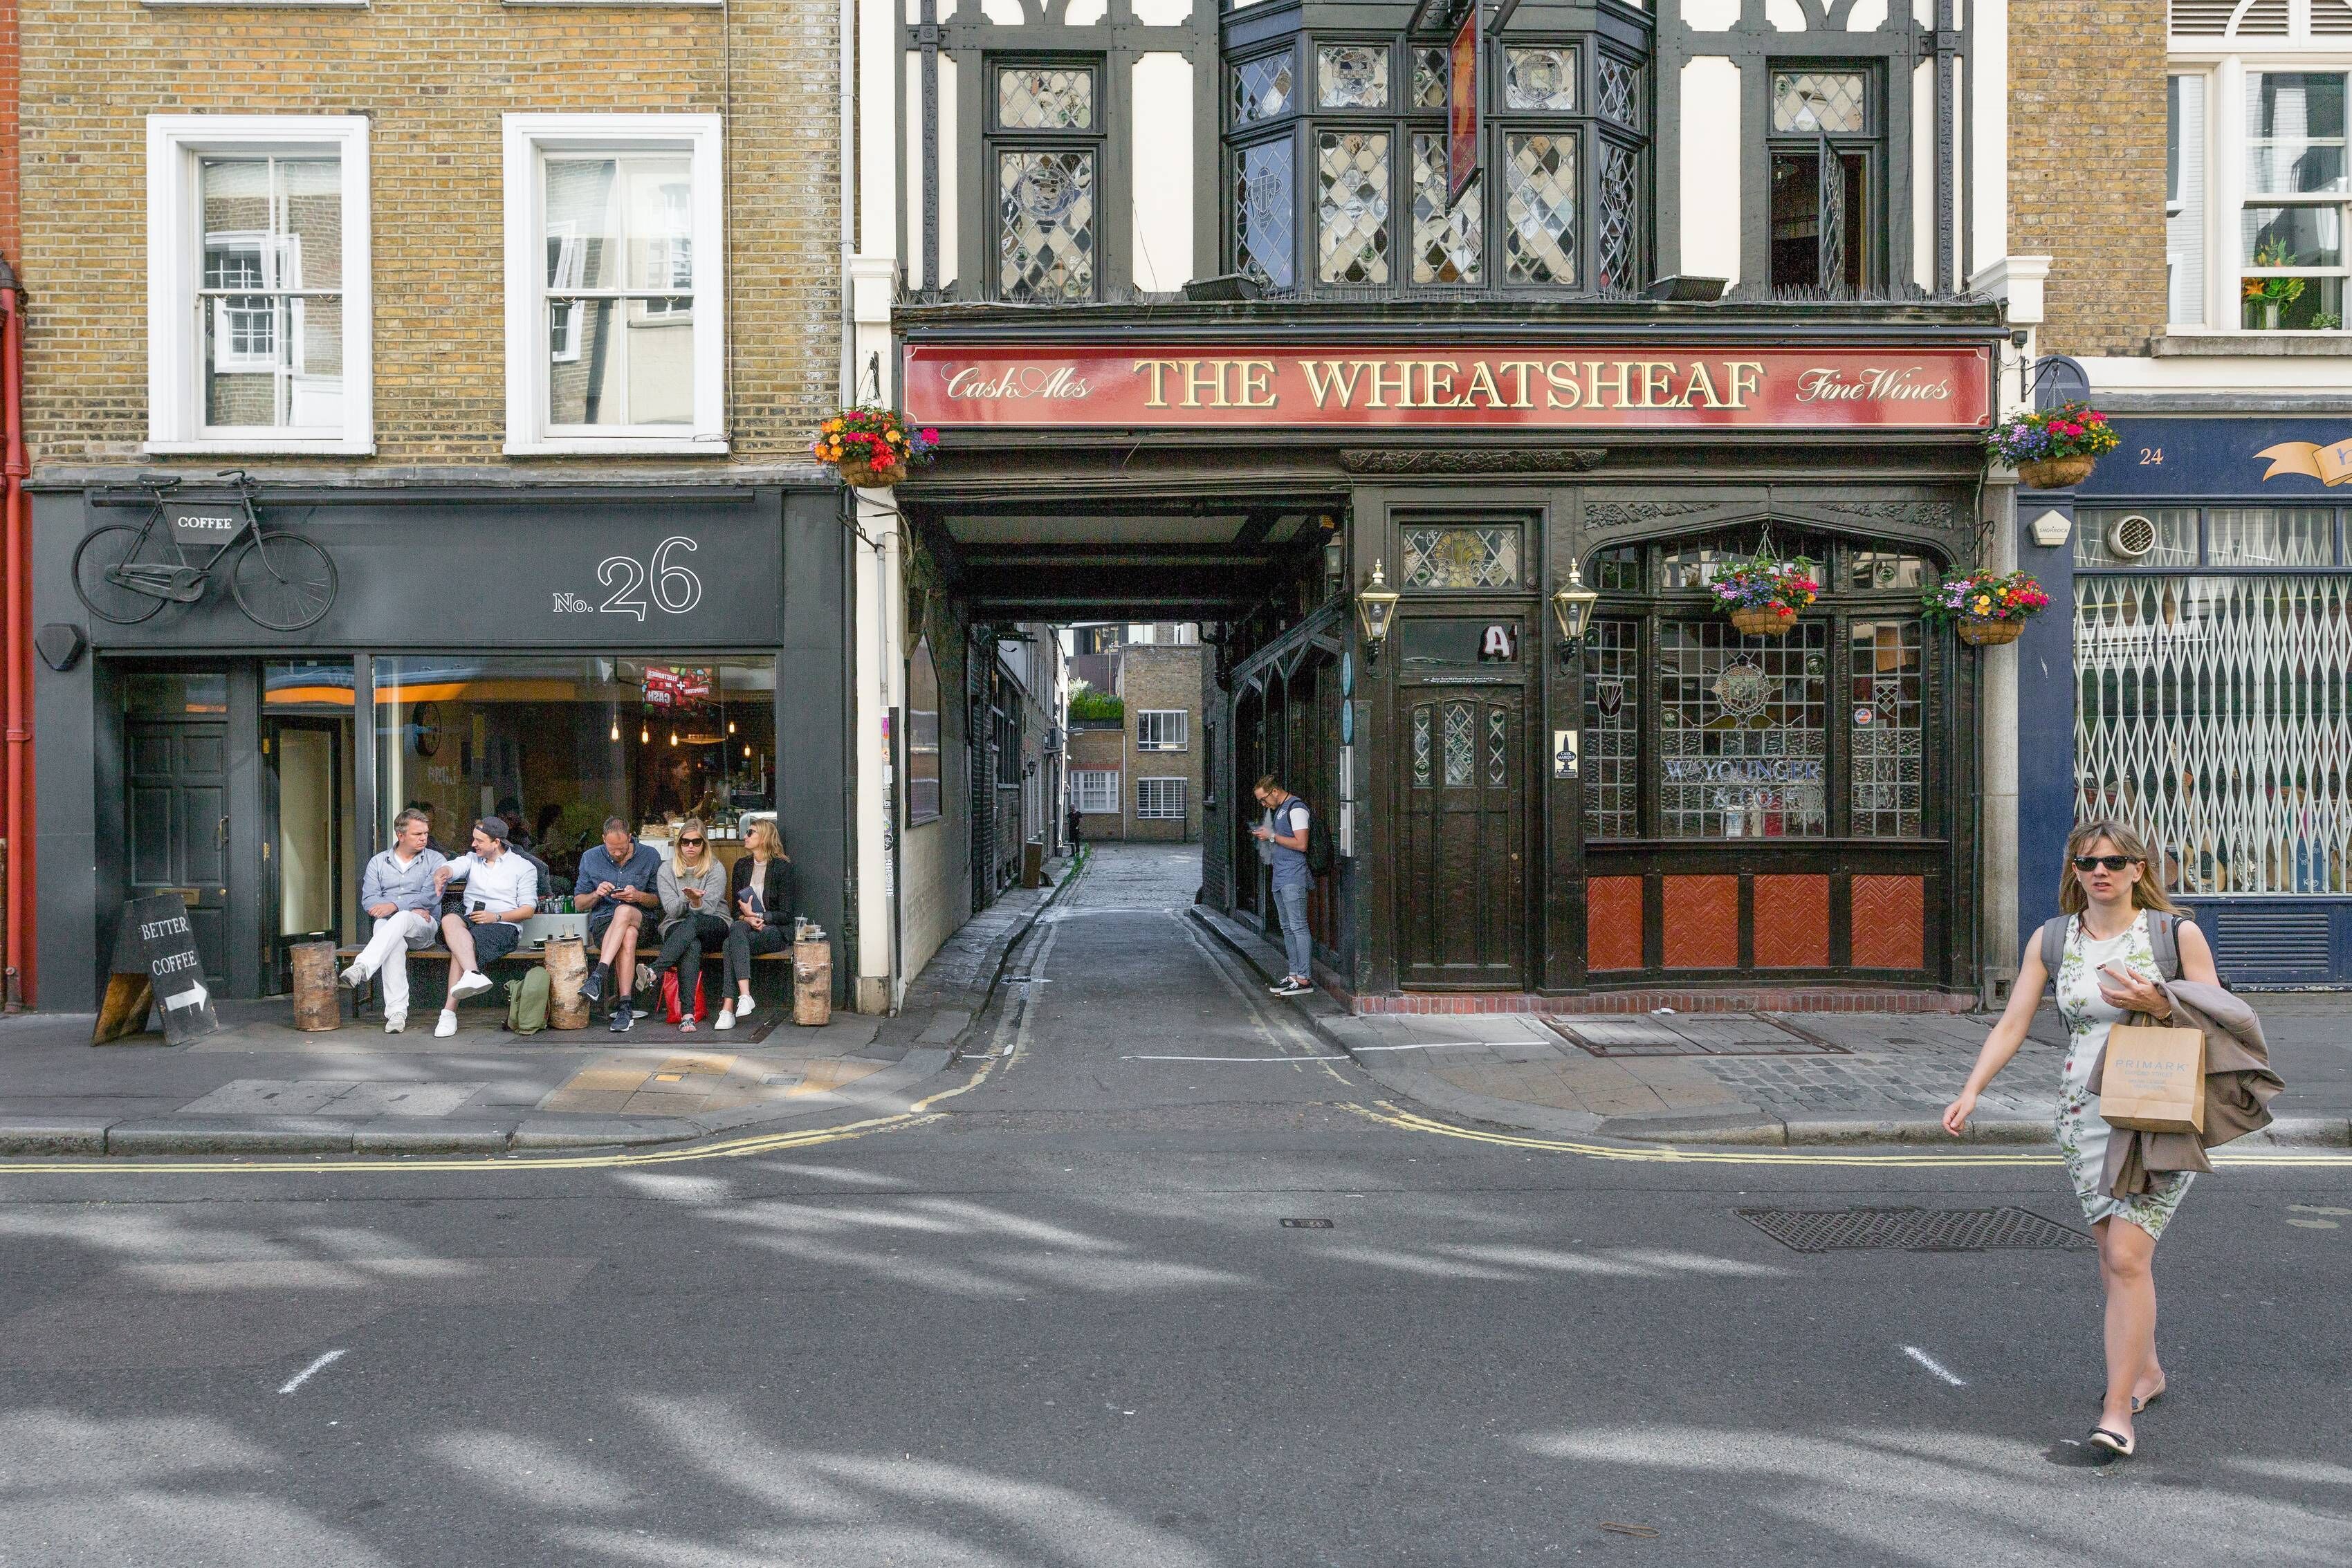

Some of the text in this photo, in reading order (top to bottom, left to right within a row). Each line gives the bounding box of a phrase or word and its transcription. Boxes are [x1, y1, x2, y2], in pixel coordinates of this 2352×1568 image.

[941, 362, 1094, 398] Cask Ales
[1133, 360, 1764, 408] THE WHEATSHEAF
[1796, 367, 1952, 402] Fine Wines
[2139, 448, 2164, 465] 24
[178, 517, 232, 529] COFFEE
[553, 536, 702, 622] No. 26
[1484, 625, 1518, 657] A
[1702, 760, 1821, 782] YOUNGER
[1714, 787, 1729, 807] &
[1738, 787, 1772, 807] CO
[140, 916, 190, 940] BETTER
[152, 950, 197, 976] COFFEE
[2115, 1059, 2186, 1071] PRIMARK
